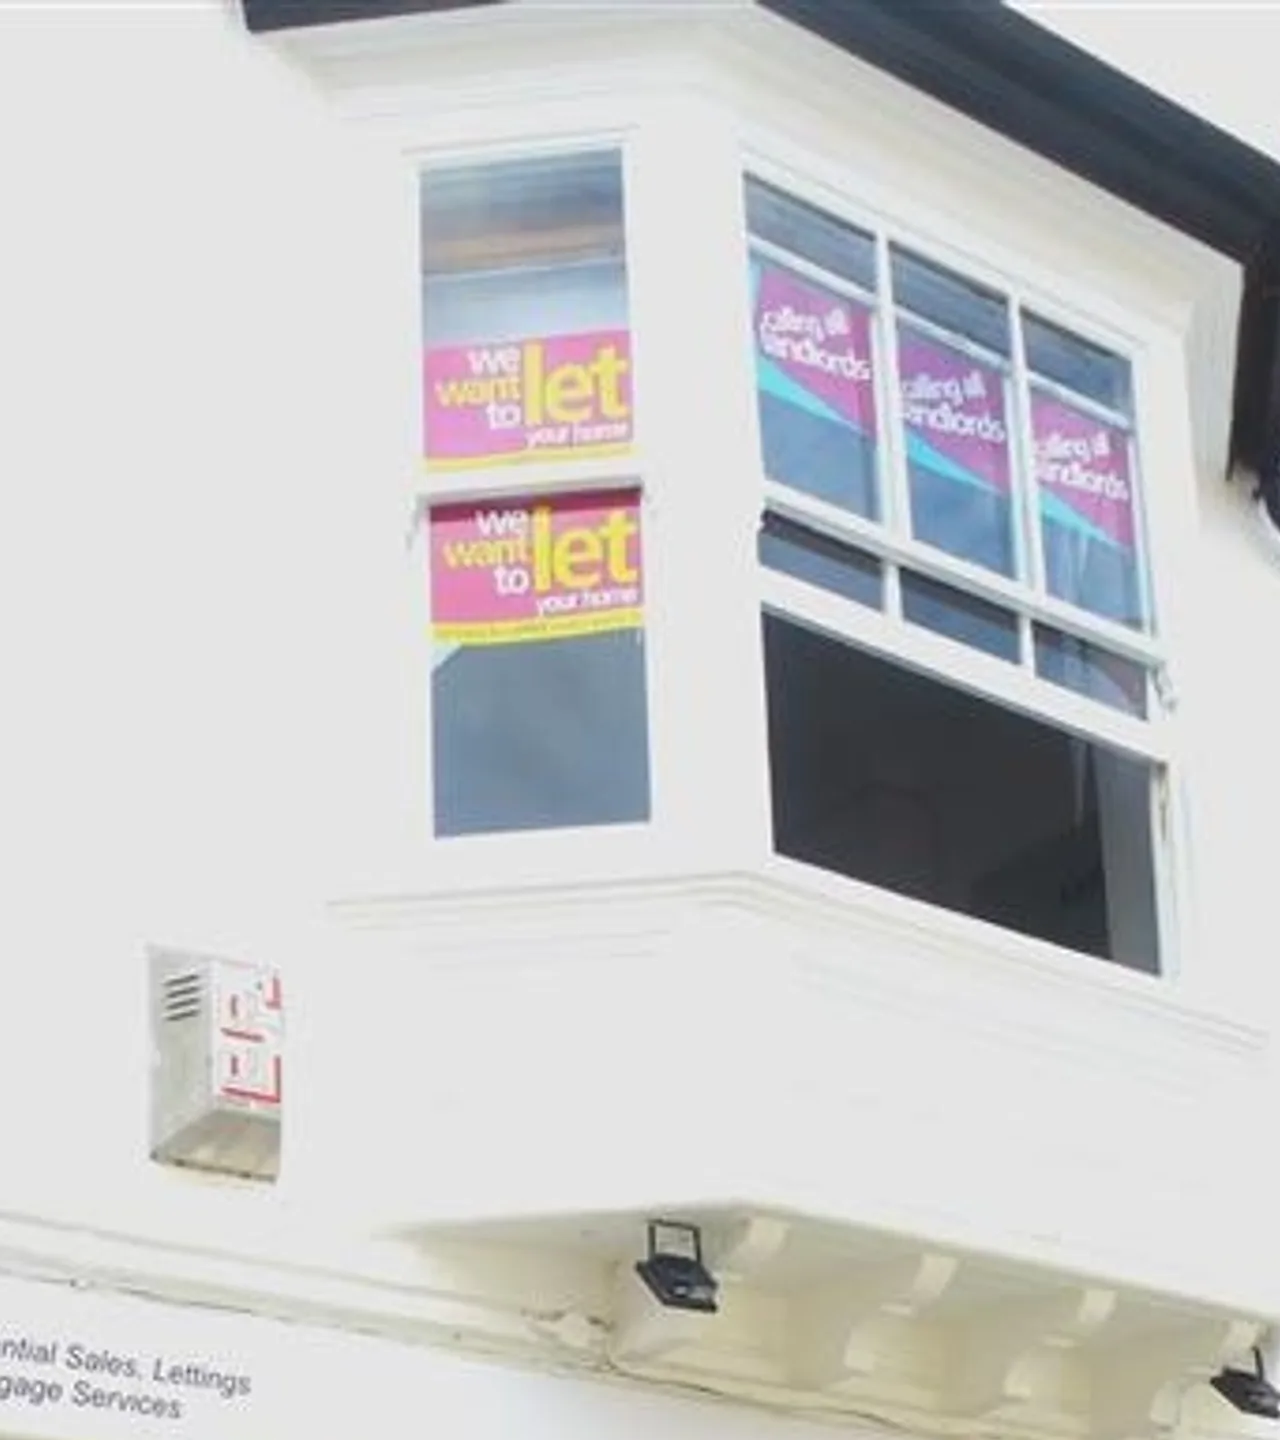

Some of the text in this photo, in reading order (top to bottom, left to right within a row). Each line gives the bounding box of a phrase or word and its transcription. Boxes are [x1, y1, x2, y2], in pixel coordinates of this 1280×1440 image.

[467, 346, 520, 376] we
[434, 377, 520, 408] want
[524, 342, 627, 426] let
[486, 400, 521, 431] to
[525, 420, 628, 450] your home
[475, 509, 528, 537] we
[442, 537, 529, 570] want
[533, 505, 638, 594] let
[494, 564, 529, 596] to
[536, 586, 640, 617] your home
[65, 1344, 143, 1381] Sales,
[153, 1357, 253, 1400] Lettings
[71, 1378, 185, 1421] Services
